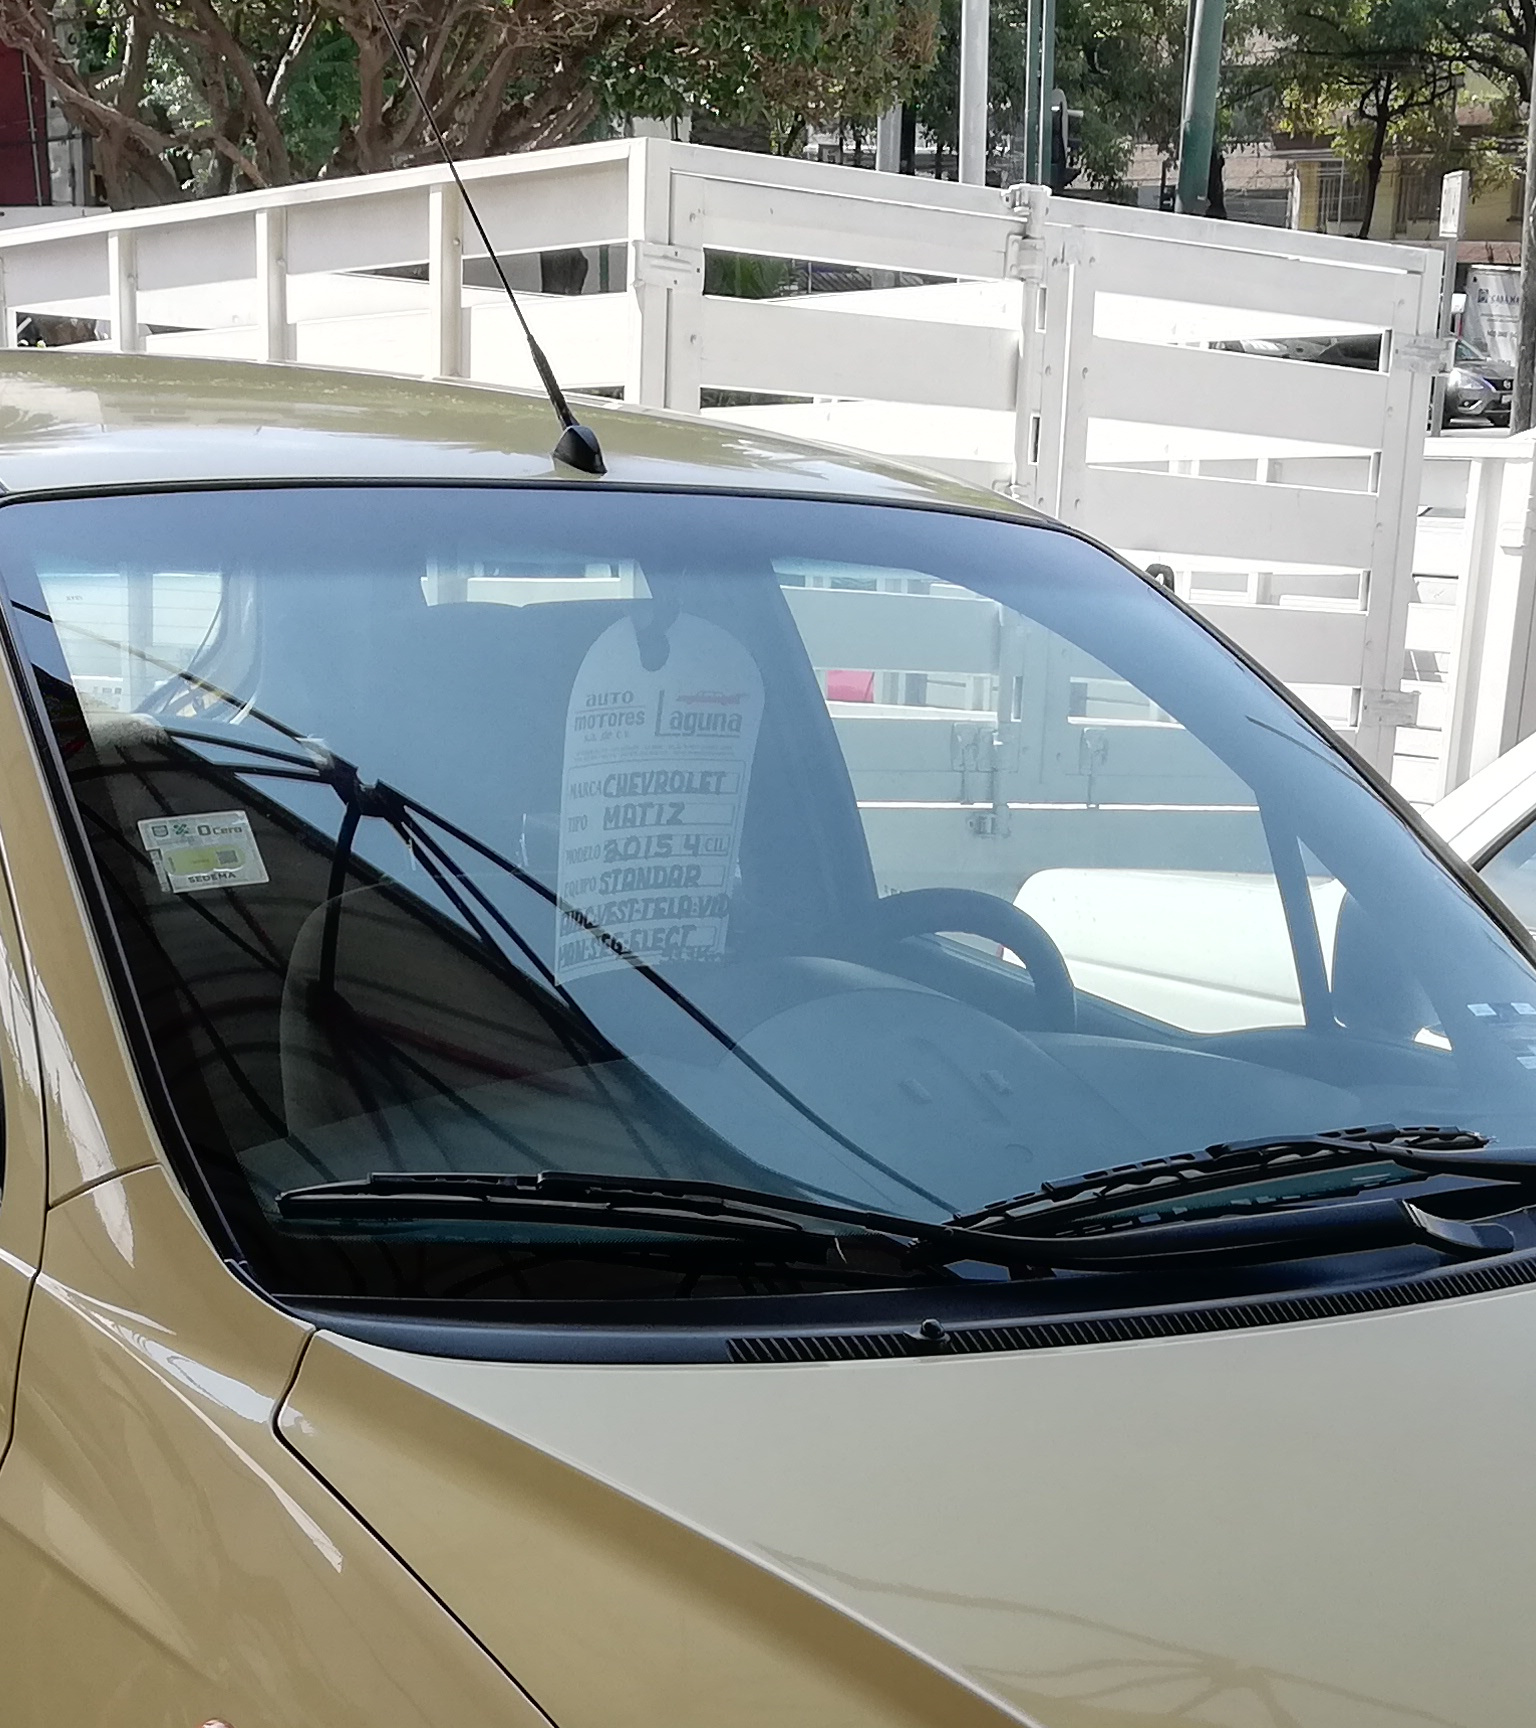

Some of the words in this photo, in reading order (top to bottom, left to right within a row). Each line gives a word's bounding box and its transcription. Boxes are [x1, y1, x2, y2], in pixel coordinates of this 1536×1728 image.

[574, 710, 645, 732] motores
[655, 689, 743, 738] Laguna
[568, 779, 603, 801] MARCA
[603, 769, 728, 799] CHEVROLET
[567, 814, 588, 833] TIPO
[603, 801, 686, 831] MATIZ
[565, 843, 601, 866] MODELO
[603, 834, 674, 864] 2015
[683, 833, 702, 857] 4
[188, 871, 238, 884] SEDEMA
[564, 876, 597, 898] EQUIPO
[599, 863, 703, 896] STANDAR
